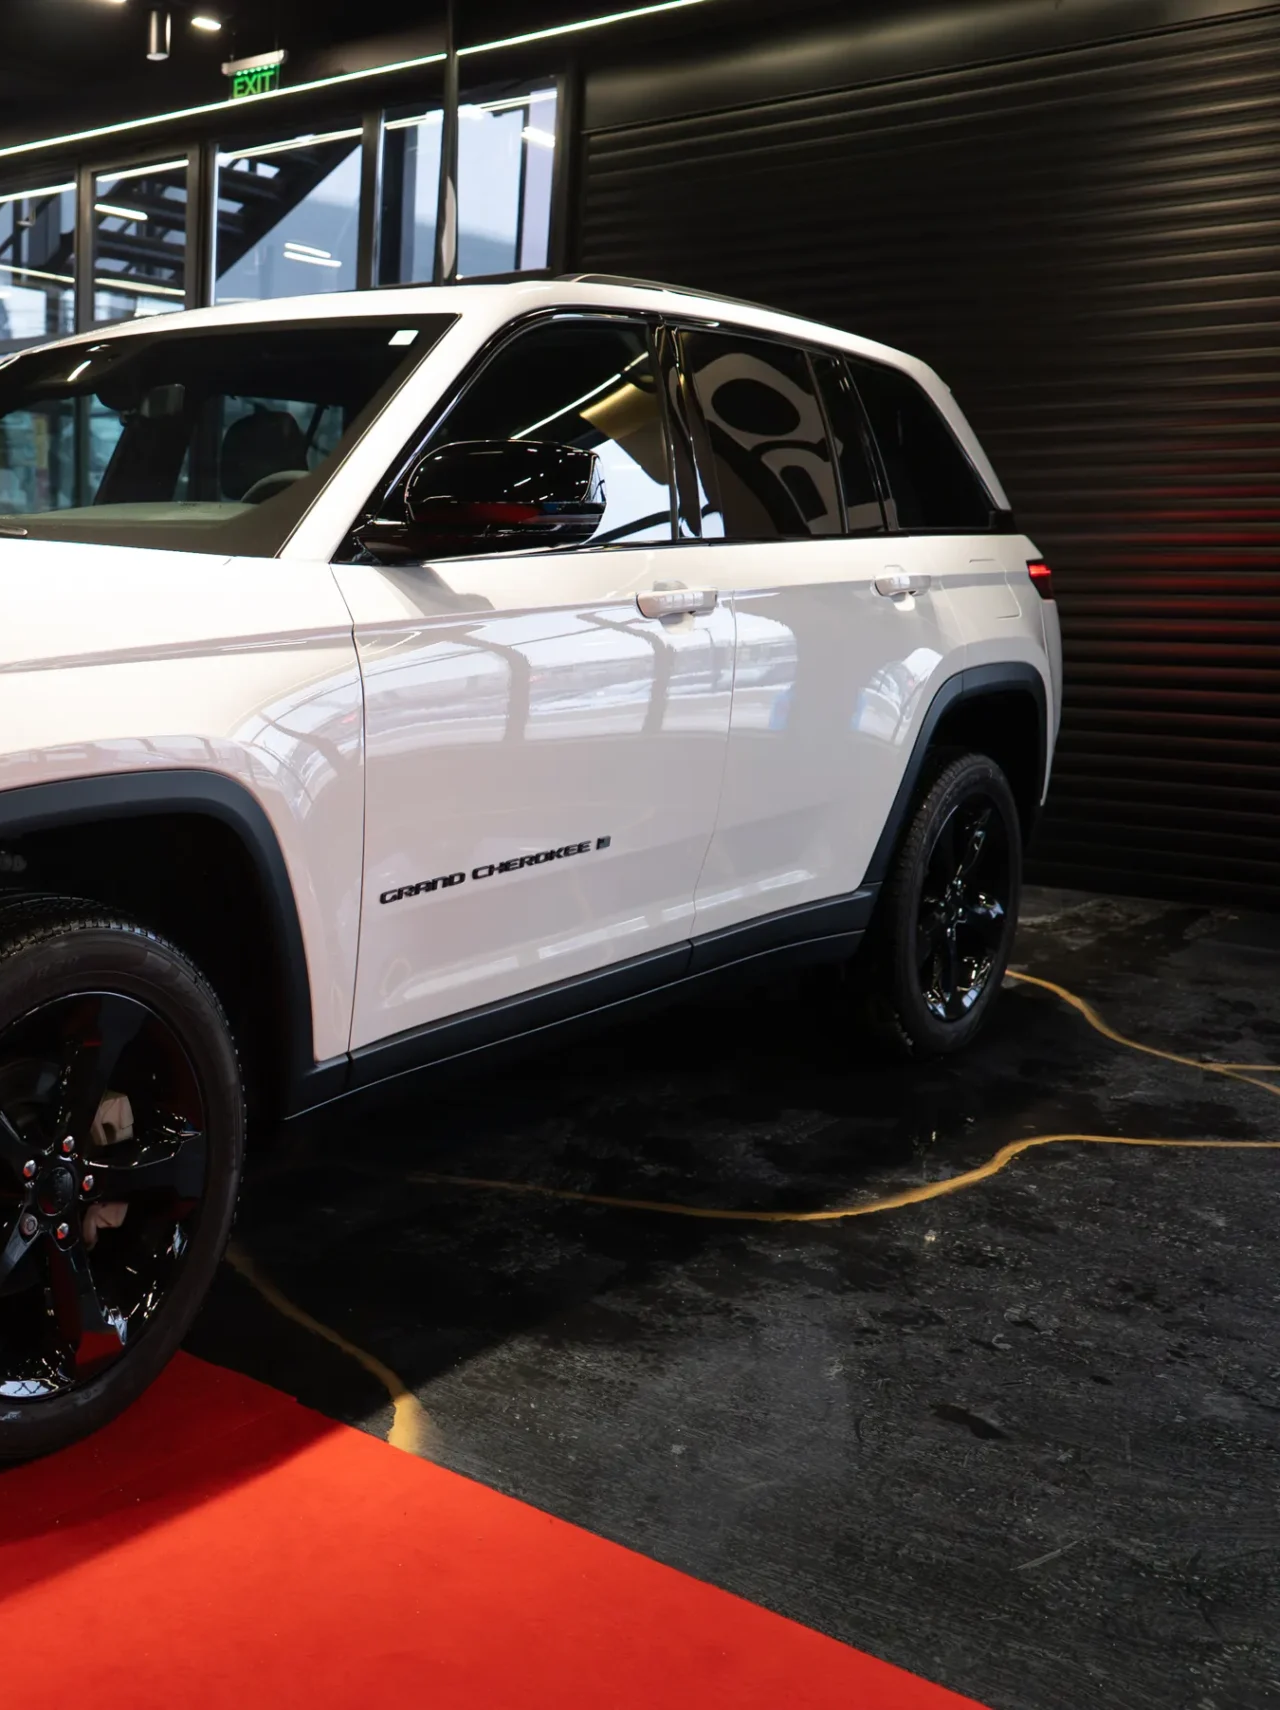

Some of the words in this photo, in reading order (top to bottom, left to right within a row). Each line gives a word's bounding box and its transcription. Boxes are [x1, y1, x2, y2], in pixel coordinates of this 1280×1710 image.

[233, 70, 275, 99] EXIT
[379, 872, 466, 905] GRAND
[471, 840, 593, 881] CHEROKEE
